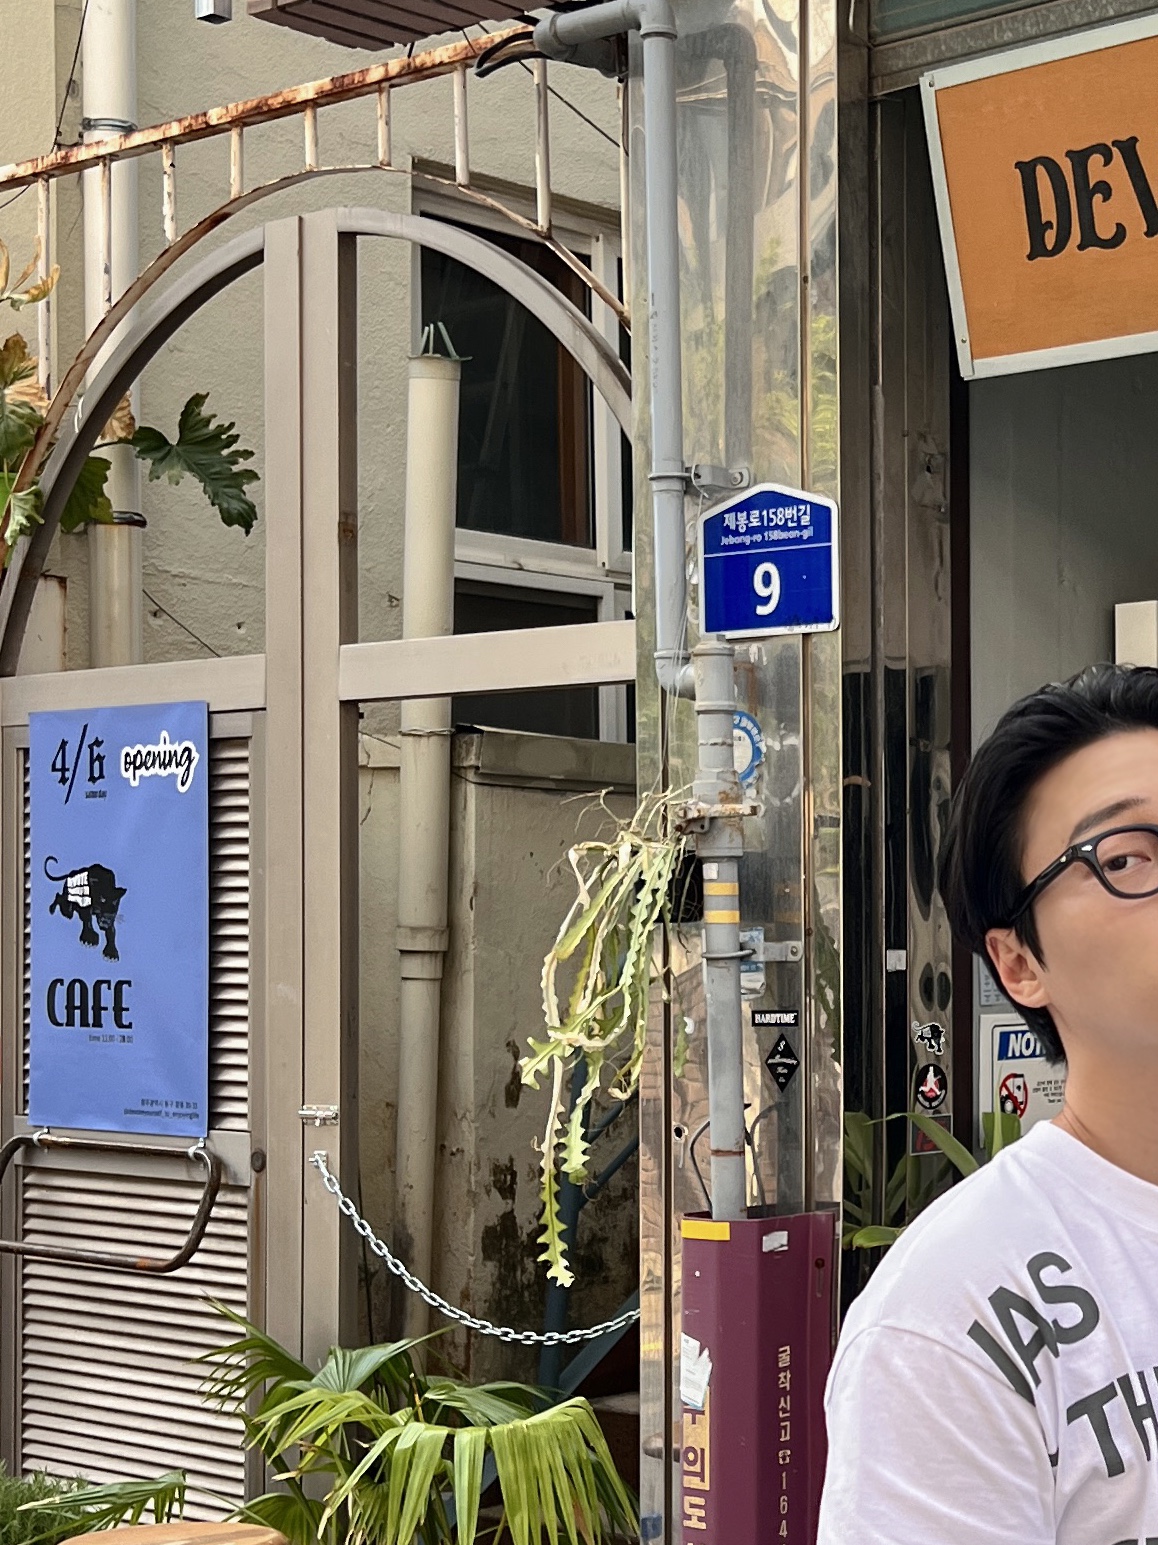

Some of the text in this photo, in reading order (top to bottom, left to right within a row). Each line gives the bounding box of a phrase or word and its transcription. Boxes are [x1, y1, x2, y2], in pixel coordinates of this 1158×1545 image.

[723, 504, 811, 533] 제봉로158번길
[753, 562, 780, 616] 9
[51, 723, 106, 805] 4/6
[123, 736, 195, 787] opening
[47, 978, 133, 1030] CAFE
[754, 1012, 796, 1024] HARDTIME
[778, 1345, 792, 1442] 굴착신고
